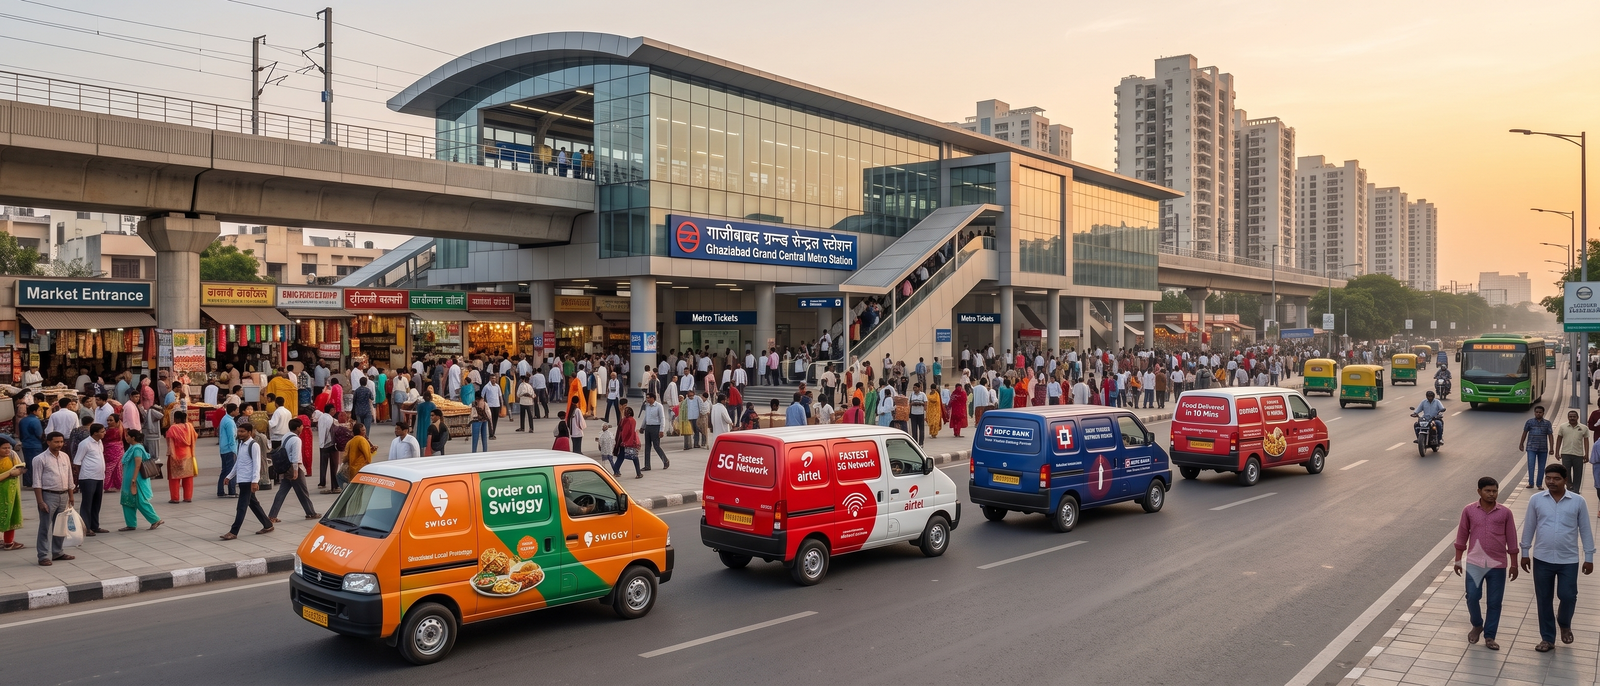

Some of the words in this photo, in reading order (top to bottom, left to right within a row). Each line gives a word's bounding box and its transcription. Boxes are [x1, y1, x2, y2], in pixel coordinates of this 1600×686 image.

[706, 223, 760, 245] गाजीबाबद
[705, 243, 751, 257] Ghaziabad
[752, 248, 777, 260] Grand
[778, 250, 806, 262] Central
[807, 252, 828, 264] Metro
[828, 254, 853, 266] Station
[26, 286, 78, 300] Market
[82, 287, 144, 301] Entrance
[692, 313, 713, 322] Metro
[713, 313, 739, 322] Tickets
[976, 315, 994, 323] Tickets
[1197, 403, 1225, 411] Delivered
[1202, 410, 1219, 418] Mins
[993, 428, 1011, 436] HDFC
[1011, 430, 1030, 438] BANK
[717, 453, 735, 470] 5G
[736, 453, 764, 466] Fastest
[838, 450, 869, 461] FASTEST
[735, 463, 769, 476] Network
[837, 462, 846, 471] 5G
[847, 459, 876, 470] Network
[797, 469, 822, 482] airtel
[487, 485, 524, 499] Order
[526, 484, 543, 495] on
[489, 498, 544, 515] Swiggy
[904, 499, 924, 511] airtel
[425, 518, 458, 529] SWIGGY
[594, 530, 629, 543] SWIGGY
[319, 541, 354, 560] SWIGGY
